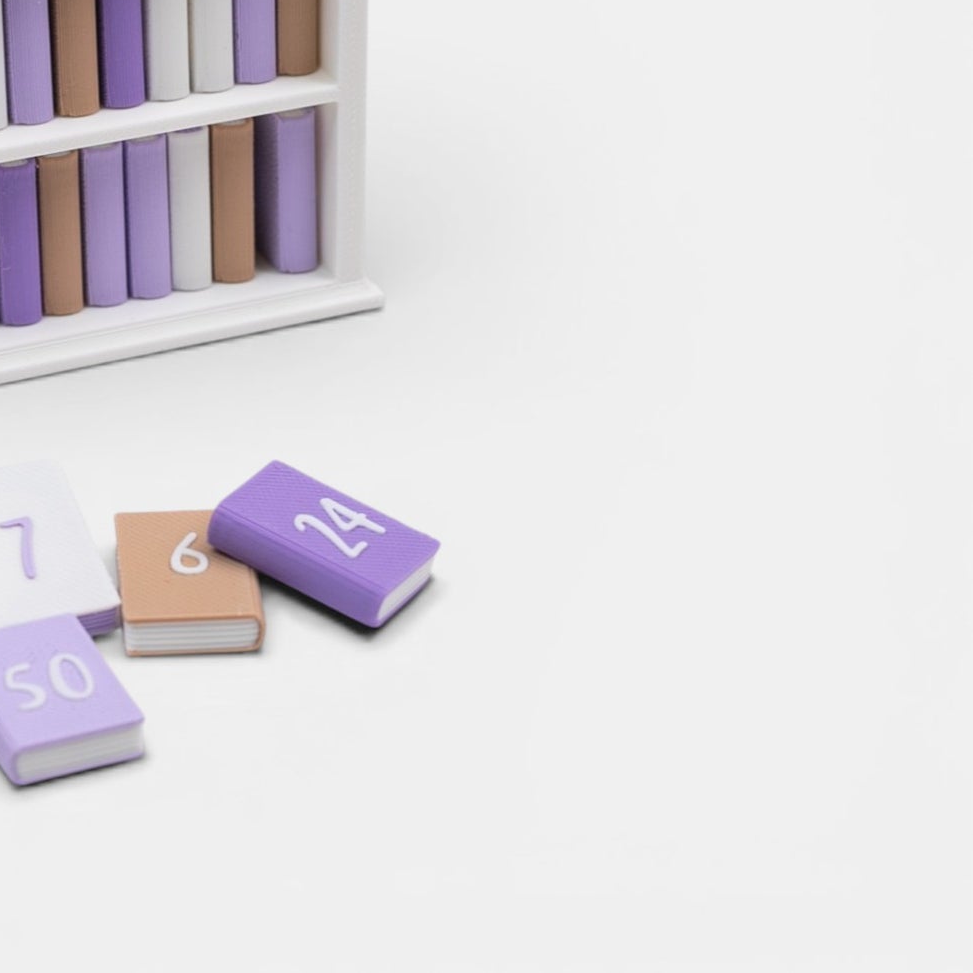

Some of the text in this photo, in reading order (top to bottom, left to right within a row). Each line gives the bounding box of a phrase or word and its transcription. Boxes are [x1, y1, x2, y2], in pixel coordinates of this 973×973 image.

[170, 532, 209, 574] 6
[295, 497, 386, 558] 24
[4, 653, 94, 710] 50
